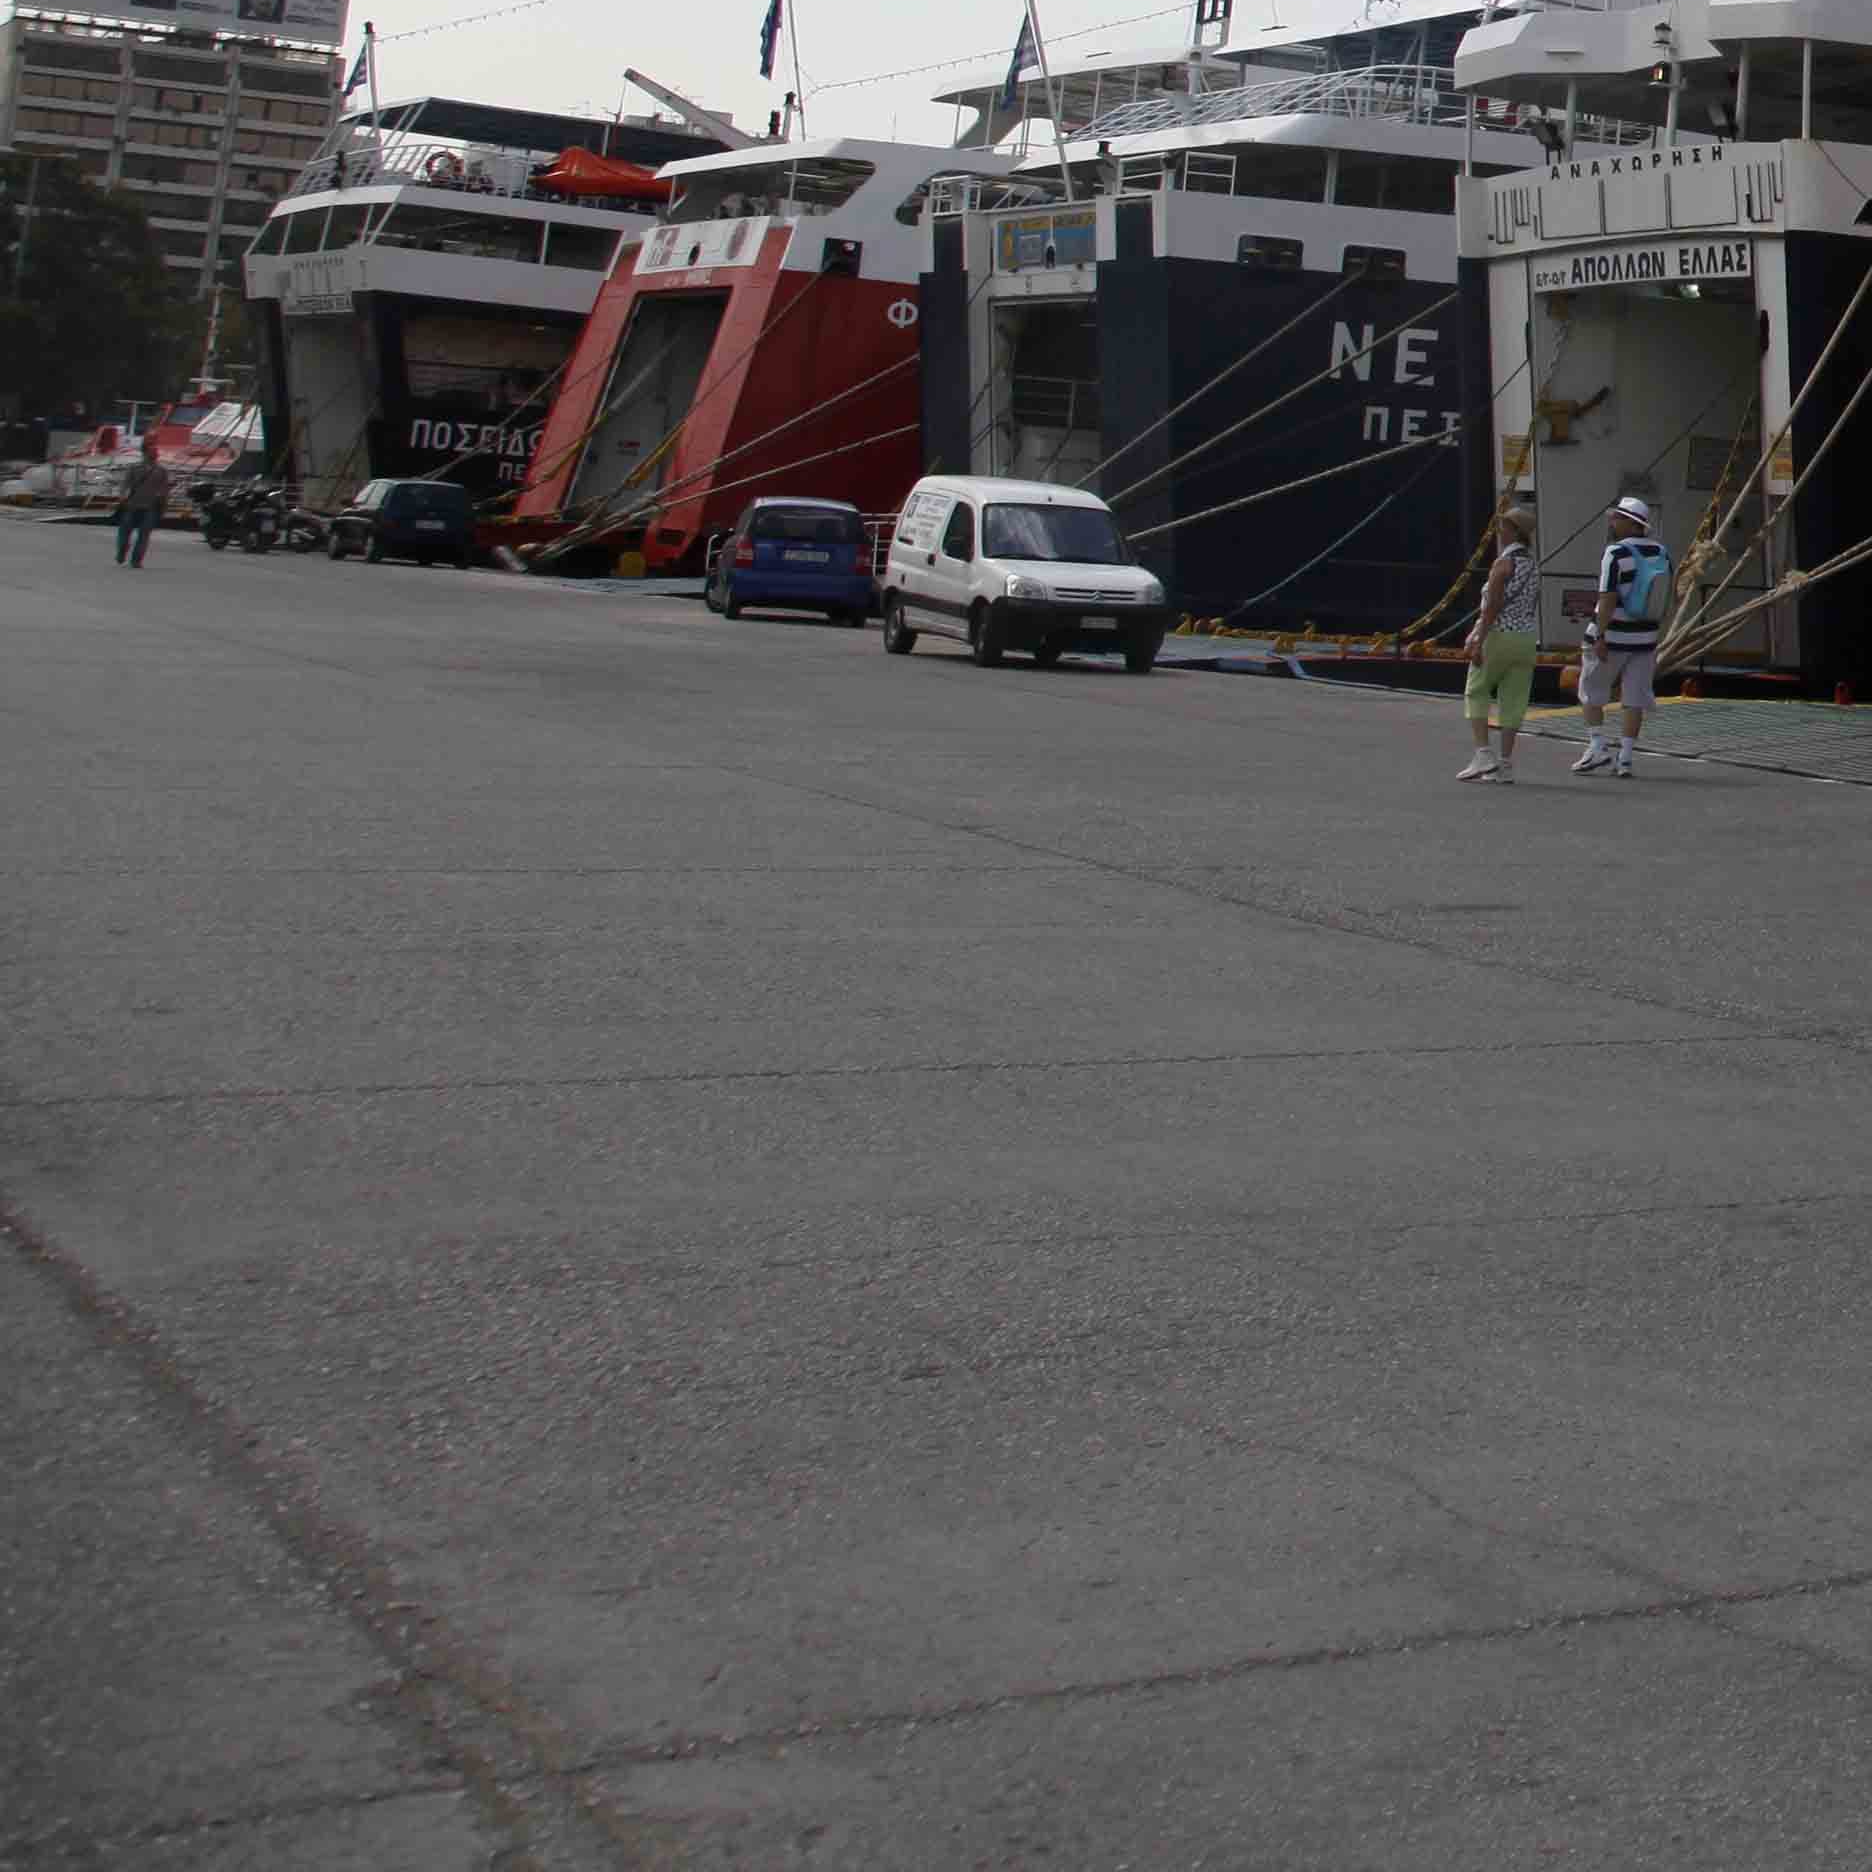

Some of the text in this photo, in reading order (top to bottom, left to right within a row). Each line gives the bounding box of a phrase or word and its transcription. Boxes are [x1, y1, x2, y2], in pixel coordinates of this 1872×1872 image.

[1551, 145, 1722, 180] ΑΝΑΧΩΡΗΣΗ
[1571, 251, 1665, 285] ΑΠΟΛΛΩΝ
[1679, 244, 1747, 276] ΕΛΛΑΣ
